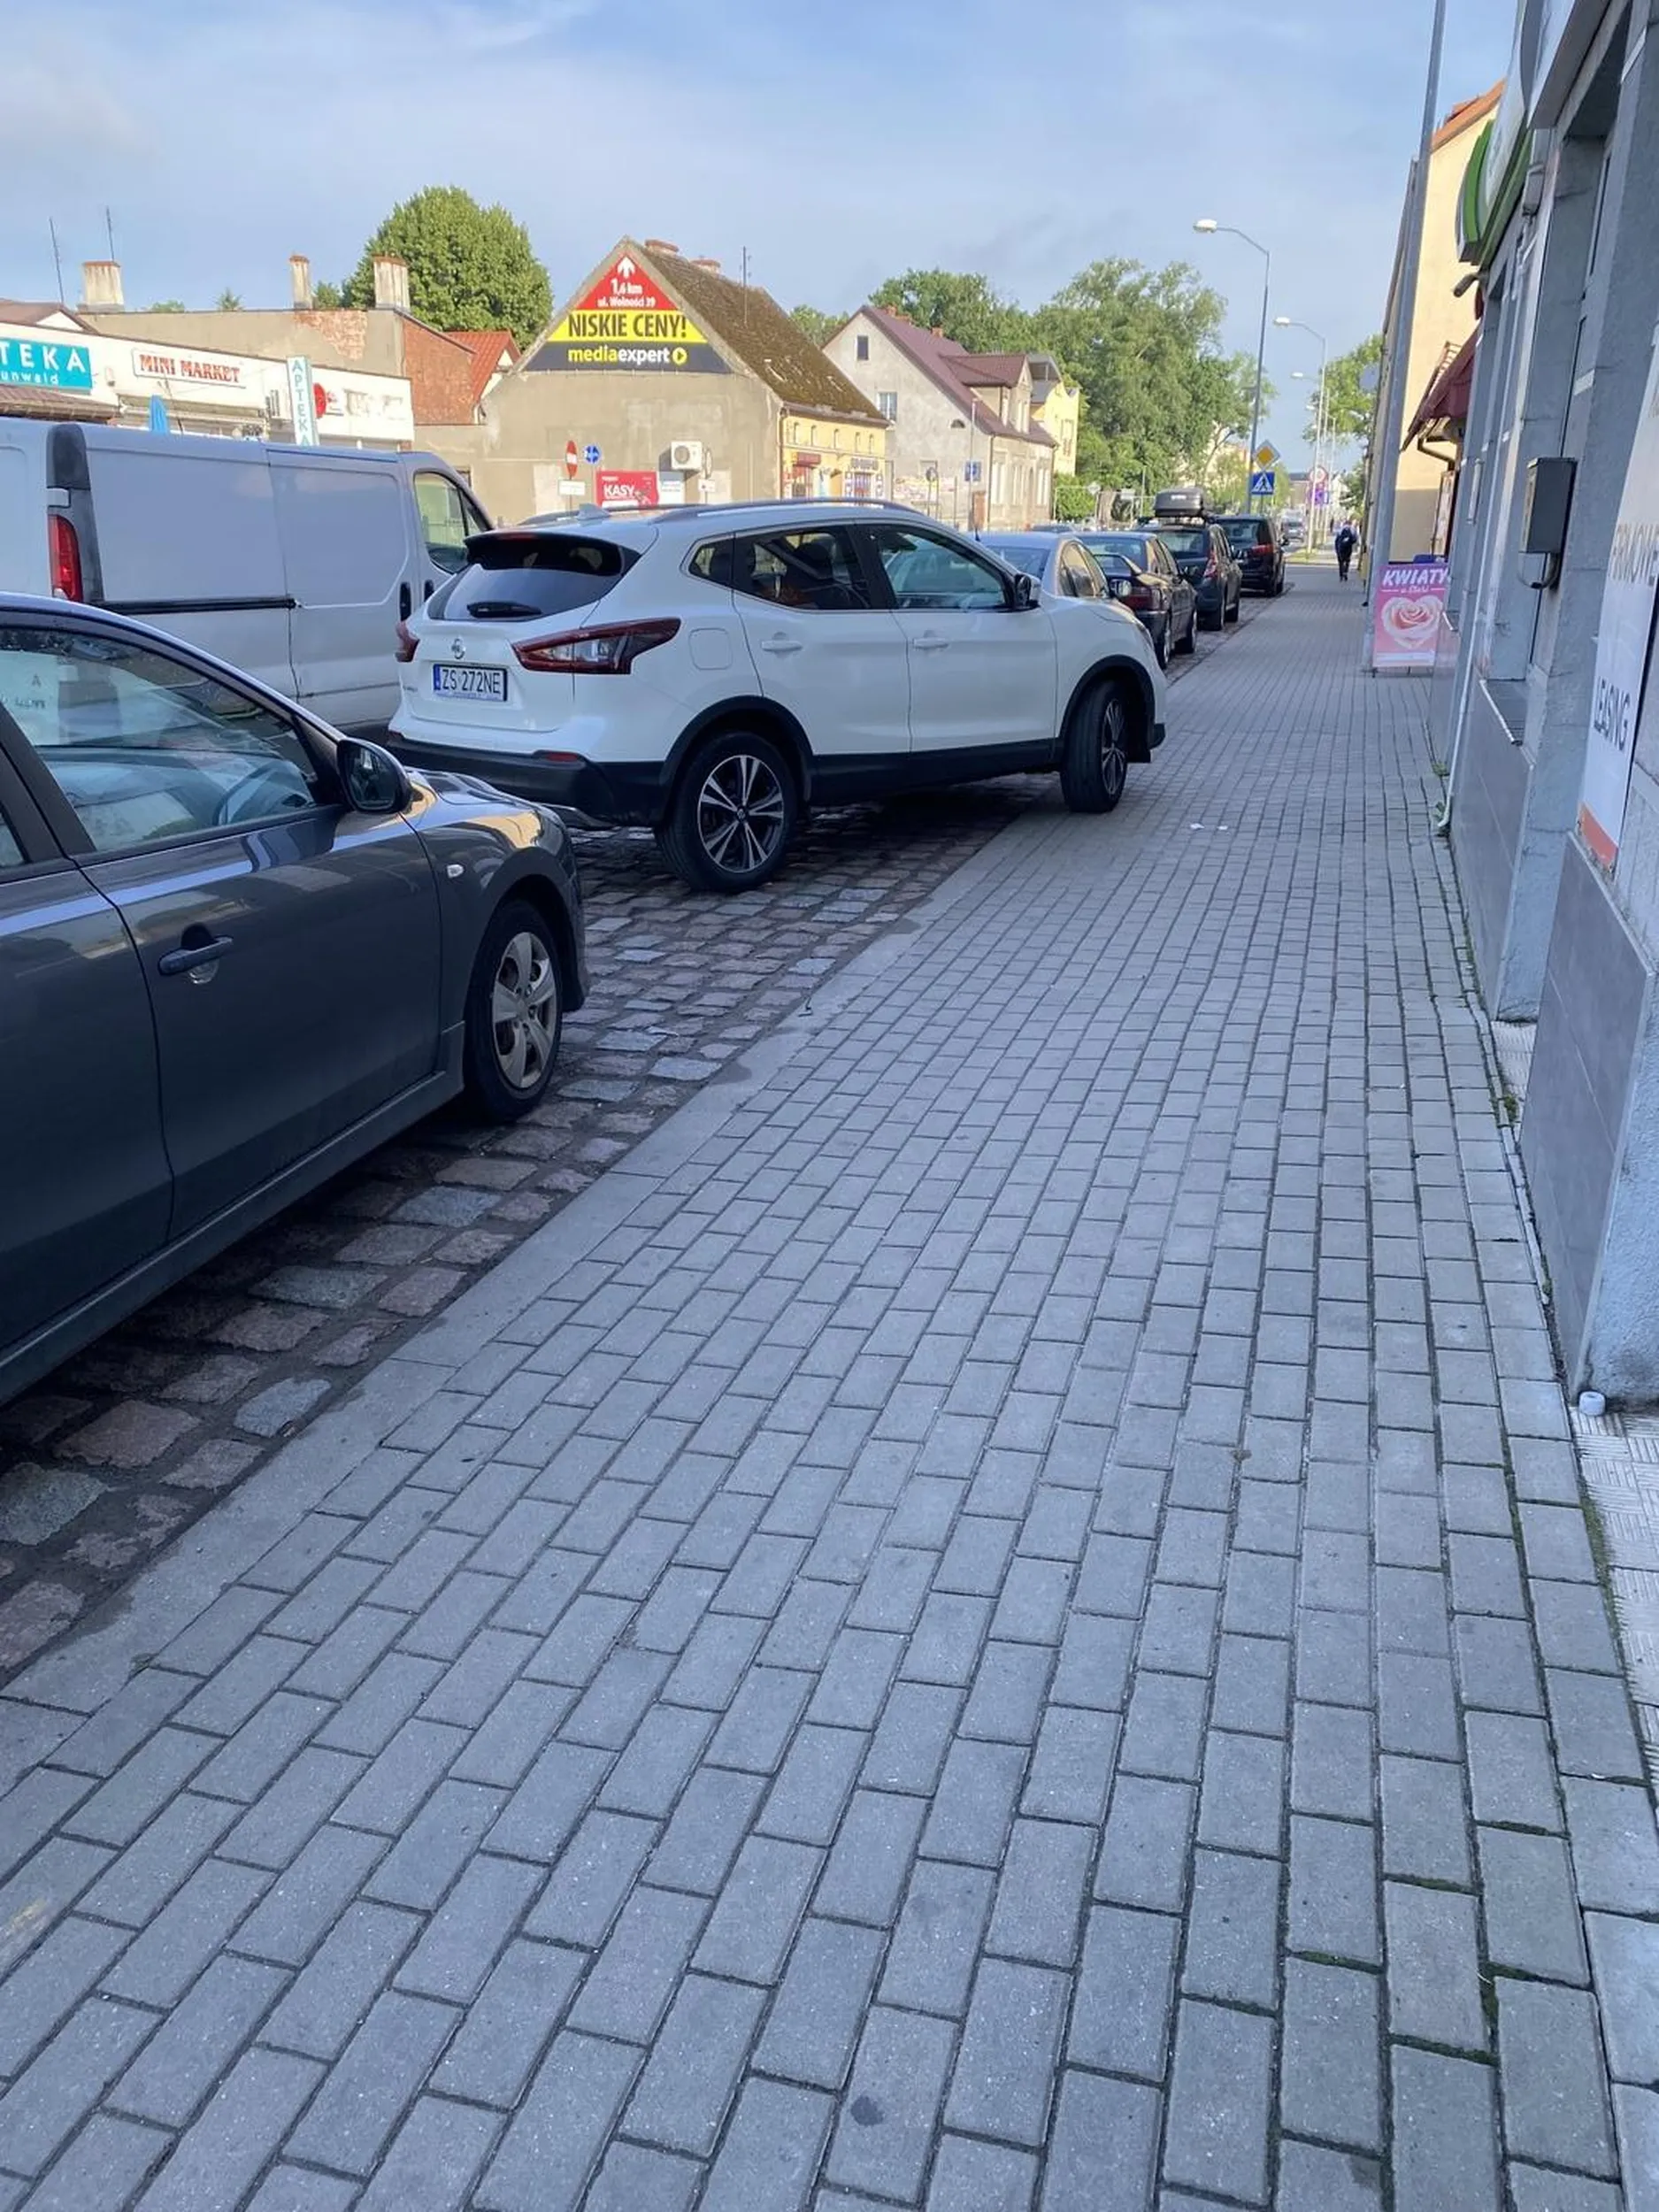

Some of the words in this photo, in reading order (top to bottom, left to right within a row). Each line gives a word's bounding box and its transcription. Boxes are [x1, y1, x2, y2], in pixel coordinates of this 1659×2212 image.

[568, 313, 627, 337] NISKIE
[633, 313, 687, 338] CENY!
[568, 344, 670, 365] mediaexpert
[139, 354, 175, 375] MINI
[180, 360, 240, 382] MARKET
[292, 358, 311, 446] APTEKA
[603, 484, 634, 496] KASY
[1383, 567, 1448, 586] KWIATY
[442, 669, 457, 690] ZS
[462, 670, 501, 694] 272NE
